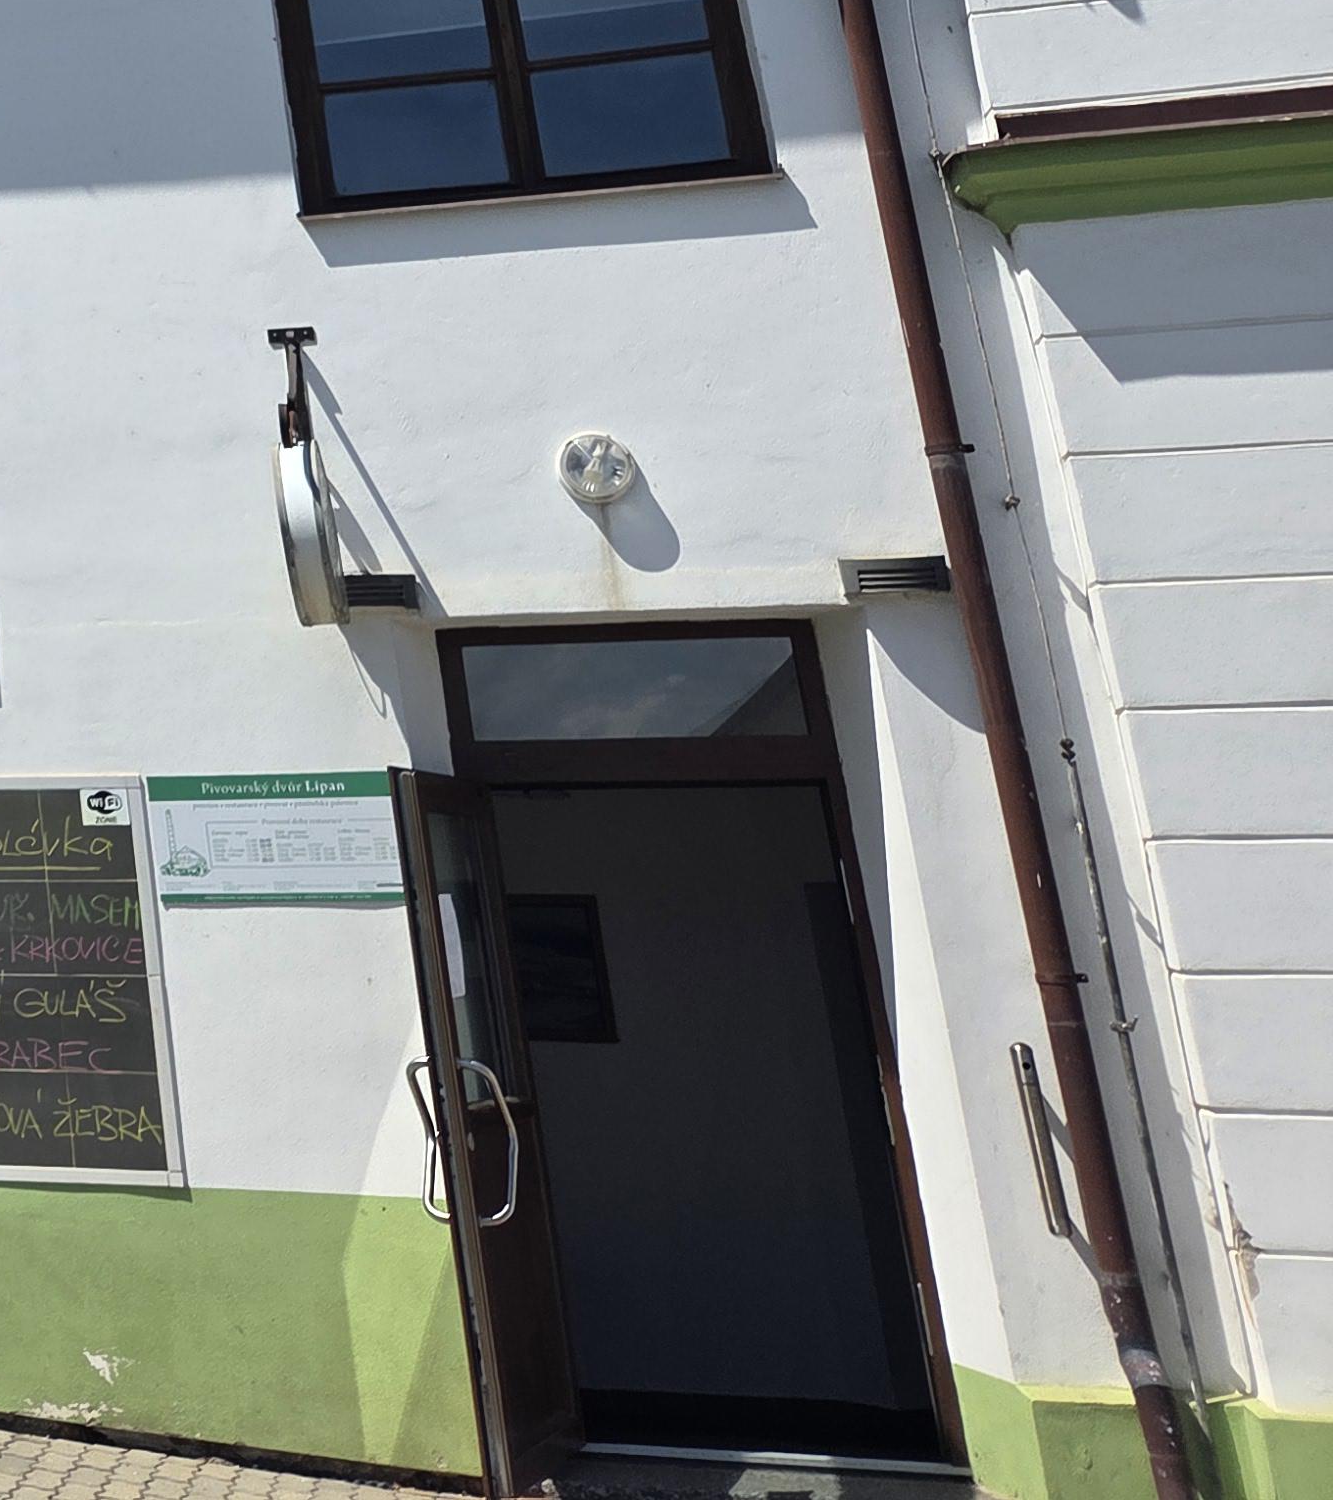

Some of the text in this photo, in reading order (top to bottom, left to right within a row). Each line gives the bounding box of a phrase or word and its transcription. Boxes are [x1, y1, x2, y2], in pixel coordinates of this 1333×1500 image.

[201, 781, 268, 795] Pivovarský
[305, 779, 345, 794] Lipan
[51, 894, 141, 931] MASEM
[11, 933, 143, 964] KRKOVICE
[13, 980, 127, 1023] GULÁŠ
[53, 1098, 163, 1146] ŽEBRA
